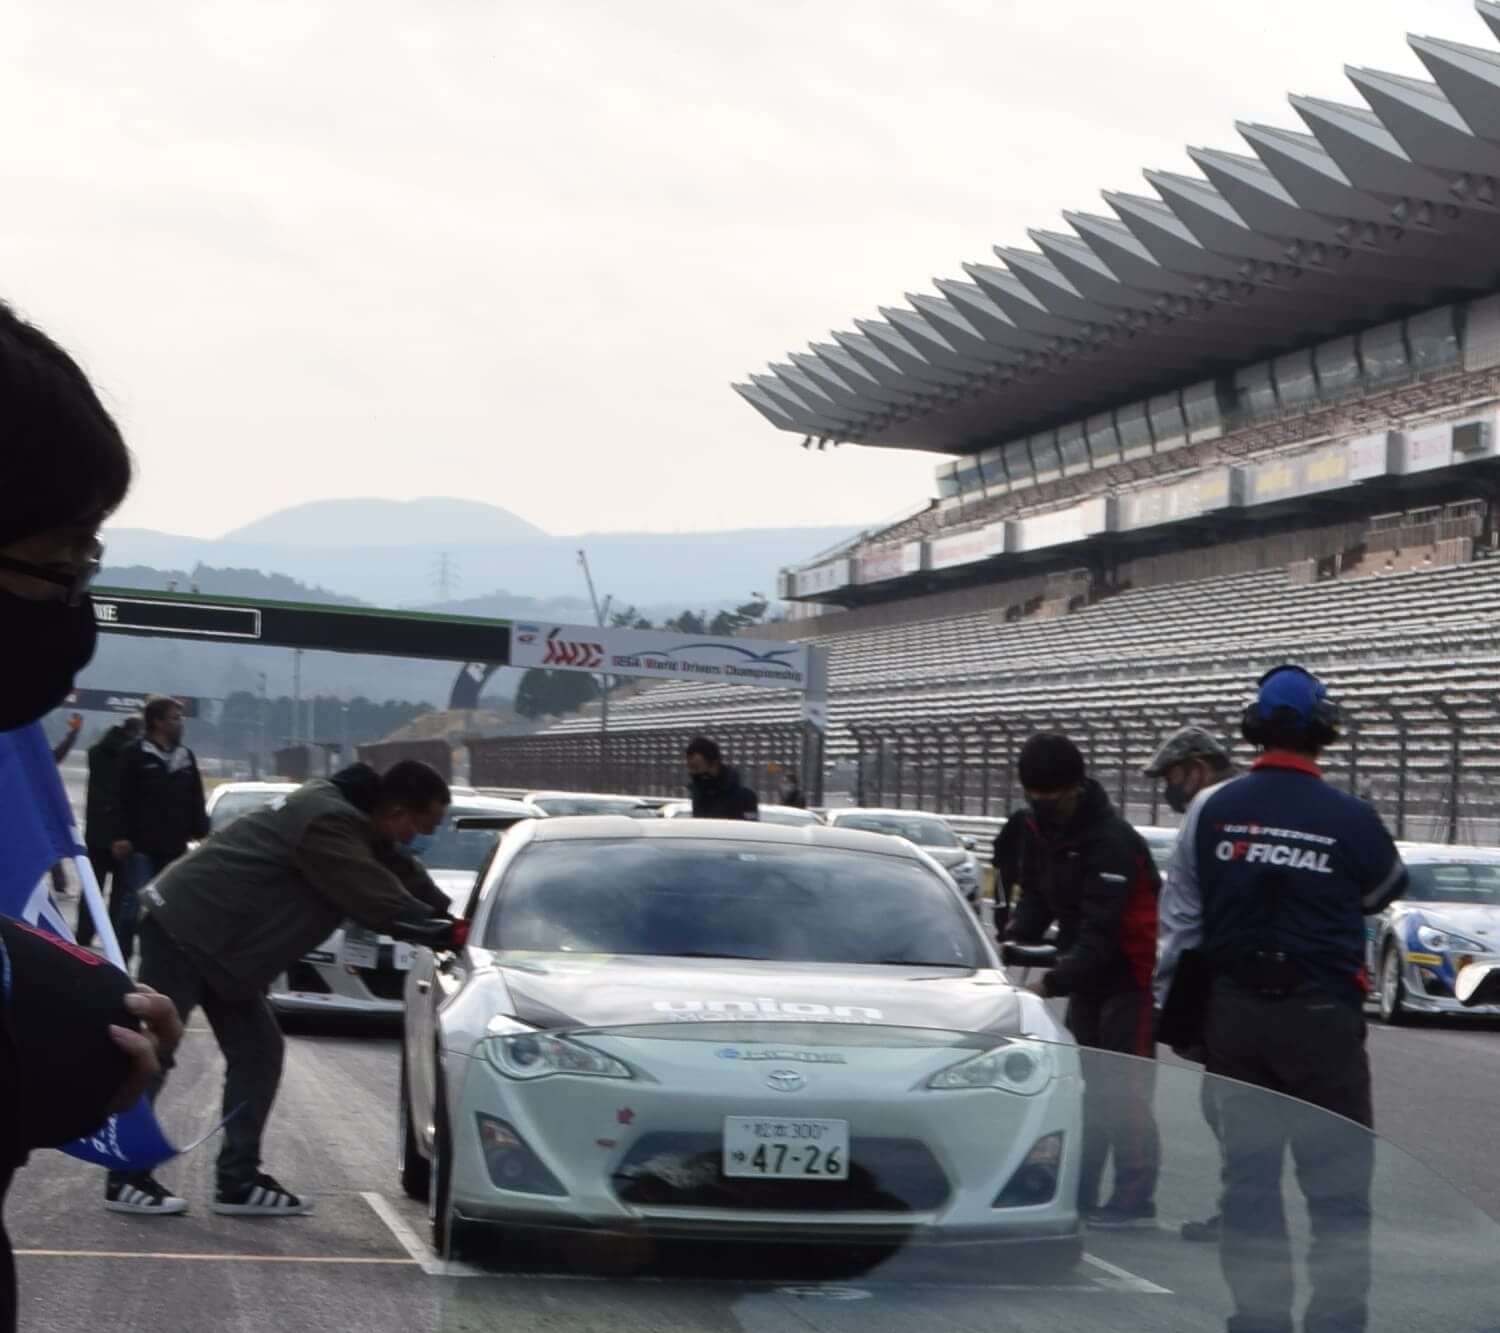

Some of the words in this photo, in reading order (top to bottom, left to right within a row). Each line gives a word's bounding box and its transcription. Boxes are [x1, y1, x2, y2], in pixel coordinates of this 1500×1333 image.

[644, 657, 678, 671] World
[680, 660, 722, 675] Drivers
[725, 663, 804, 682] Championship
[1215, 840, 1334, 874] OFFICIAL
[652, 997, 884, 1020] union
[752, 1143, 841, 1175] 47-26
